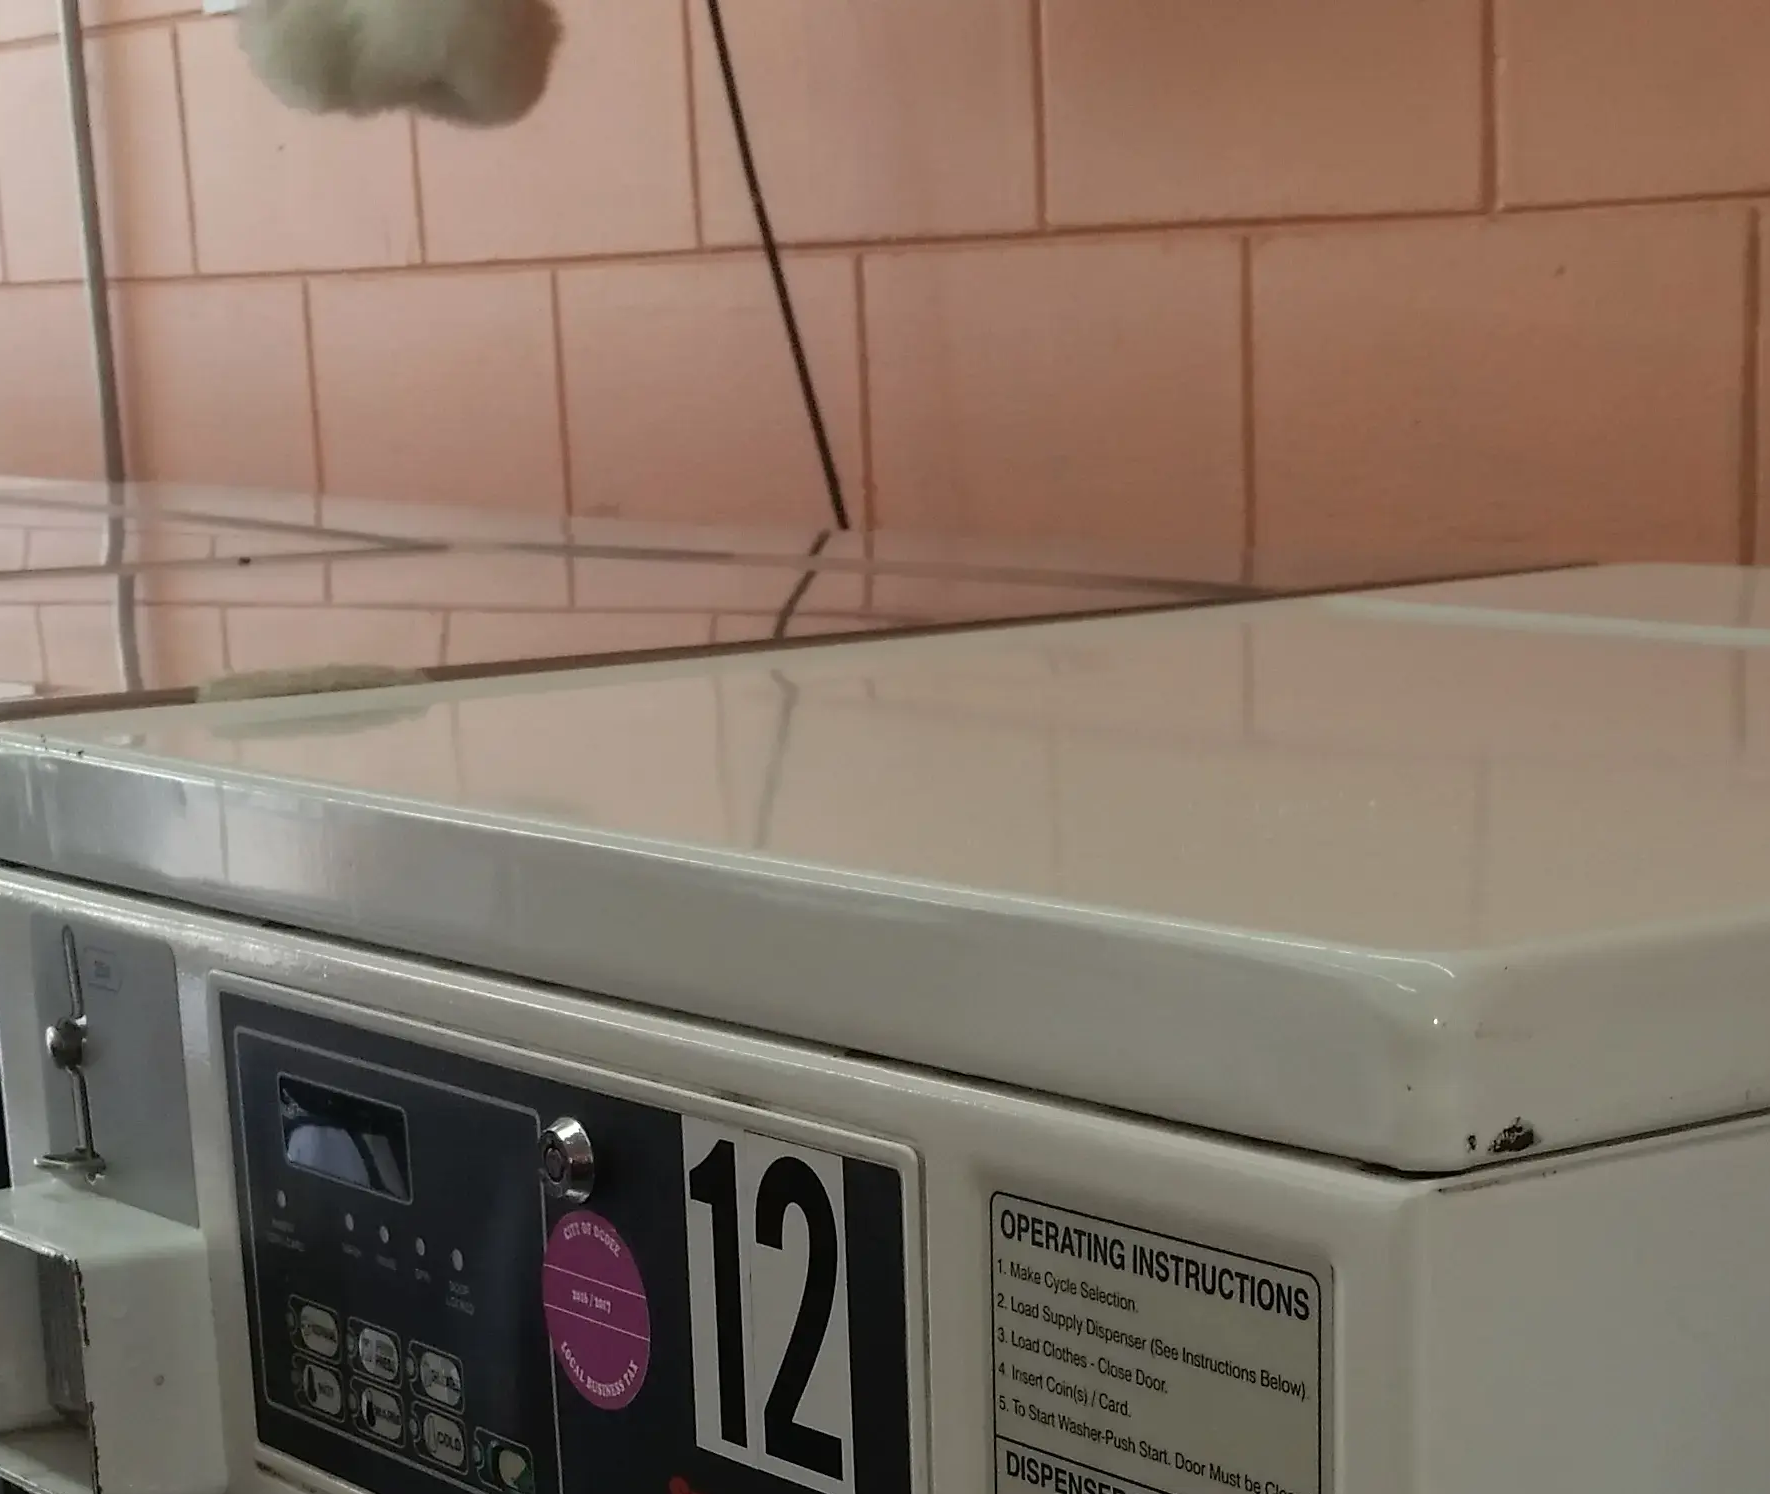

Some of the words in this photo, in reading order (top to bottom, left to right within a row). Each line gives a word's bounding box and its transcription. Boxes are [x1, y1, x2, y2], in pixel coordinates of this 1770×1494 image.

[689, 1139, 845, 1482] 12
[997, 1259, 1007, 1275] 1.
[1010, 1261, 1041, 1285] Make
[1044, 1271, 1077, 1294] Cycle
[1080, 1281, 1139, 1314] Selection.
[1000, 1209, 1125, 1271] OPERATING
[1133, 1244, 1310, 1321] INSTRUCTIONS
[997, 1293, 1008, 1310] 2.
[1010, 1296, 1039, 1319] Load
[1042, 1305, 1083, 1336] Supply
[1086, 1318, 1147, 1350] Dispenser
[1150, 1337, 1179, 1361] (See
[1182, 1347, 1256, 1384] Instructions
[997, 1327, 1008, 1344] 3.
[1011, 1330, 1040, 1354] Load
[1043, 1340, 1088, 1369] Clothes
[1098, 1357, 1132, 1382] Close
[1136, 1368, 1168, 1394] Door.
[1012, 1364, 1043, 1389] Insert
[1046, 1376, 1088, 1407] Coin(s)
[1099, 1393, 1132, 1418] Card.
[998, 1395, 1009, 1412] 5.
[1012, 1398, 1026, 1417] To
[1029, 1404, 1055, 1428] Start
[1058, 1413, 1136, 1454] Washer-Push
[1139, 1440, 1171, 1466] Start.
[1175, 1452, 1206, 1476] Door
[1209, 1462, 1241, 1488] Must
[1244, 1474, 1261, 1494] be
